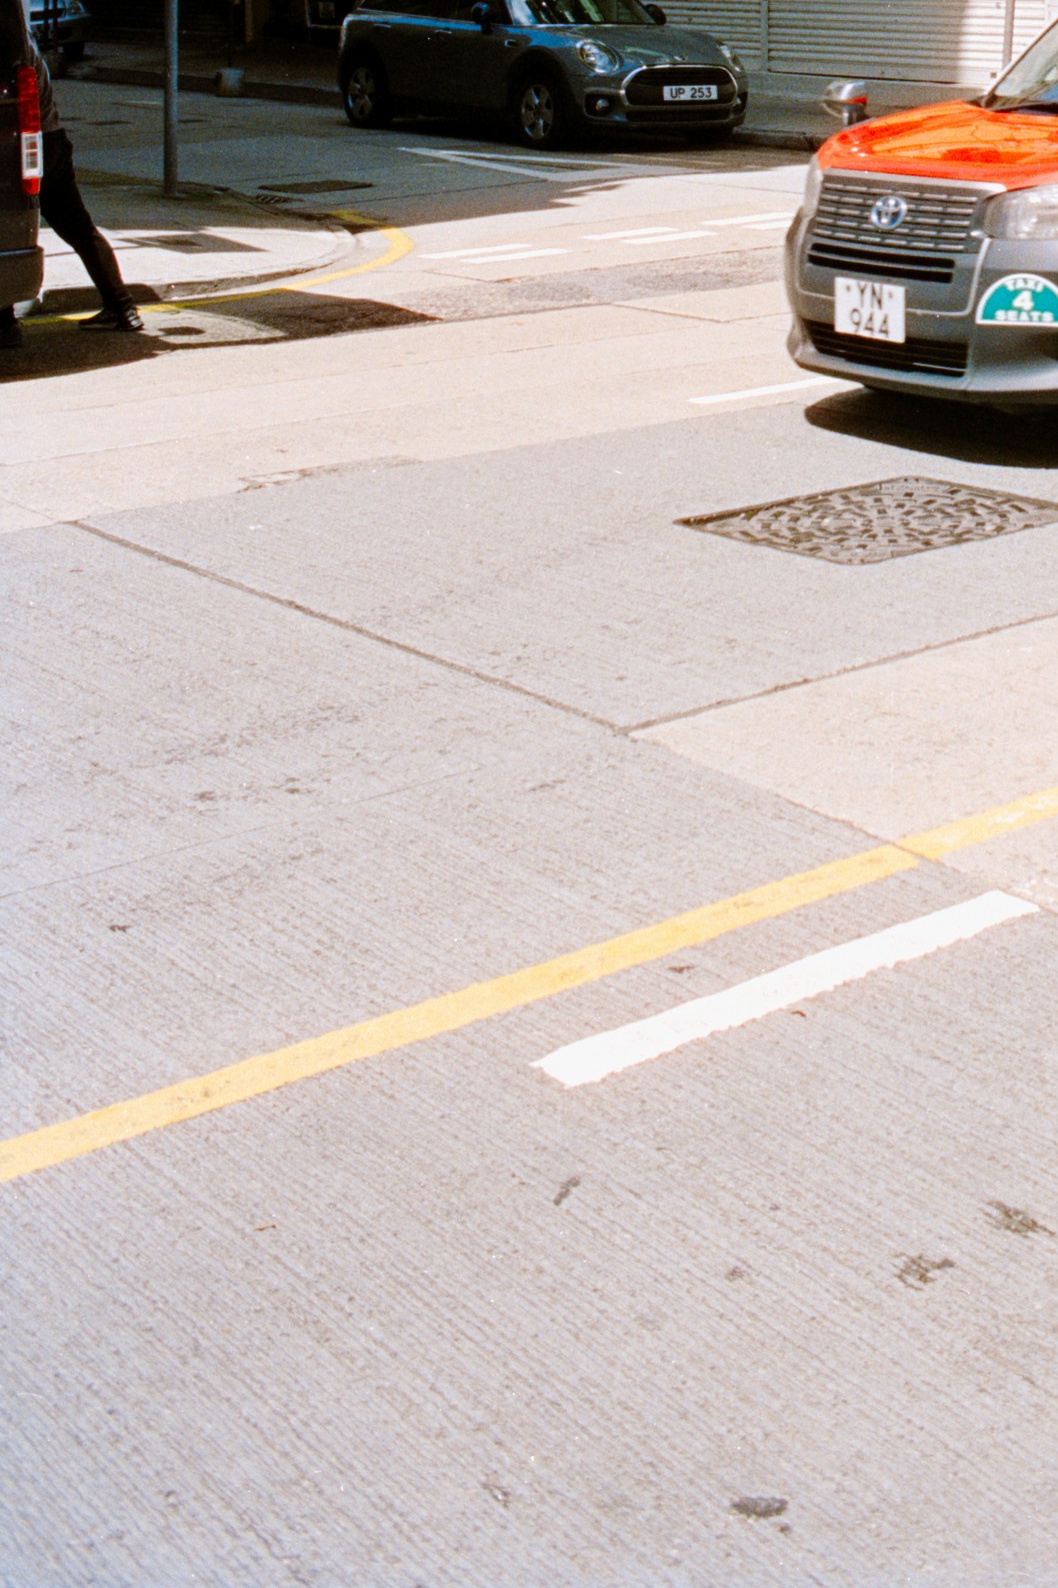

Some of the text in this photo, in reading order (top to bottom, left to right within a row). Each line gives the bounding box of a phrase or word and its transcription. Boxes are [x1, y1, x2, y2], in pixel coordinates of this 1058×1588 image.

[670, 87, 712, 99] UP 253
[1003, 278, 1045, 293] TAXI
[855, 282, 884, 310] YN
[1012, 290, 1034, 311] 4
[849, 308, 890, 338] 944
[995, 309, 1054, 322] SEATS
